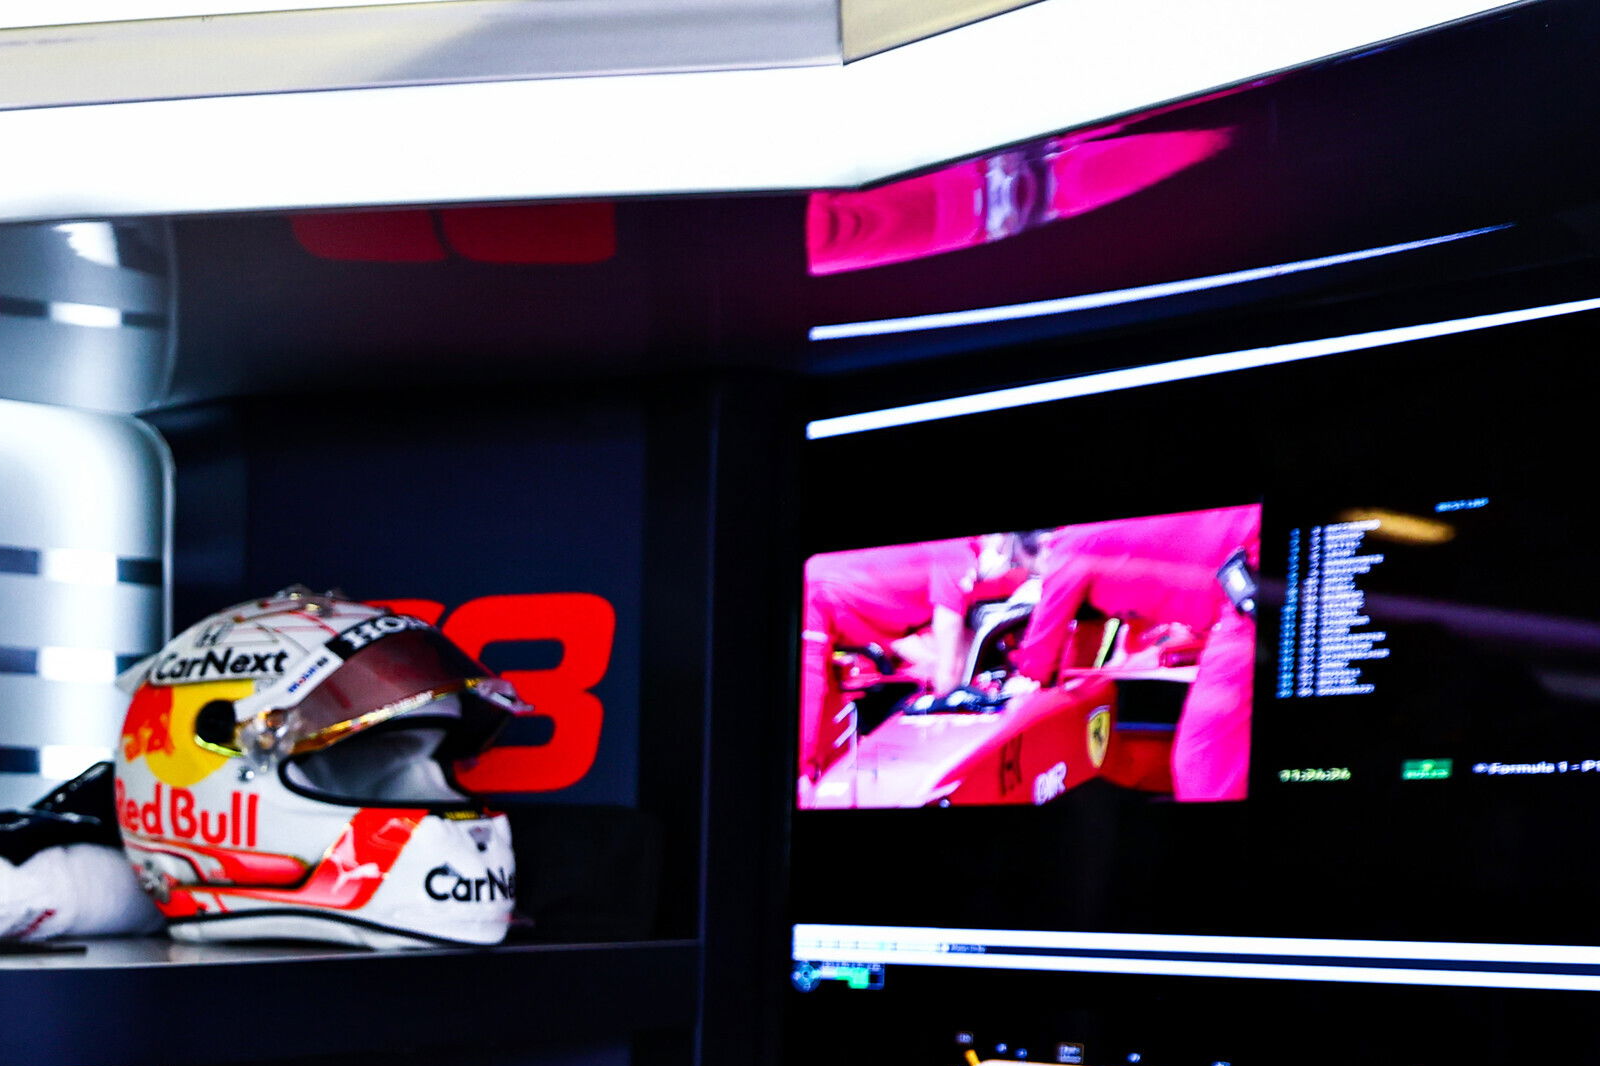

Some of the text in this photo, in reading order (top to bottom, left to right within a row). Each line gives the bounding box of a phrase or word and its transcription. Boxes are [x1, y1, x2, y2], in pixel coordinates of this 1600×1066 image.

[155, 647, 288, 681] CarNext
[370, 591, 616, 793] 3
[170, 786, 259, 847] Bull
